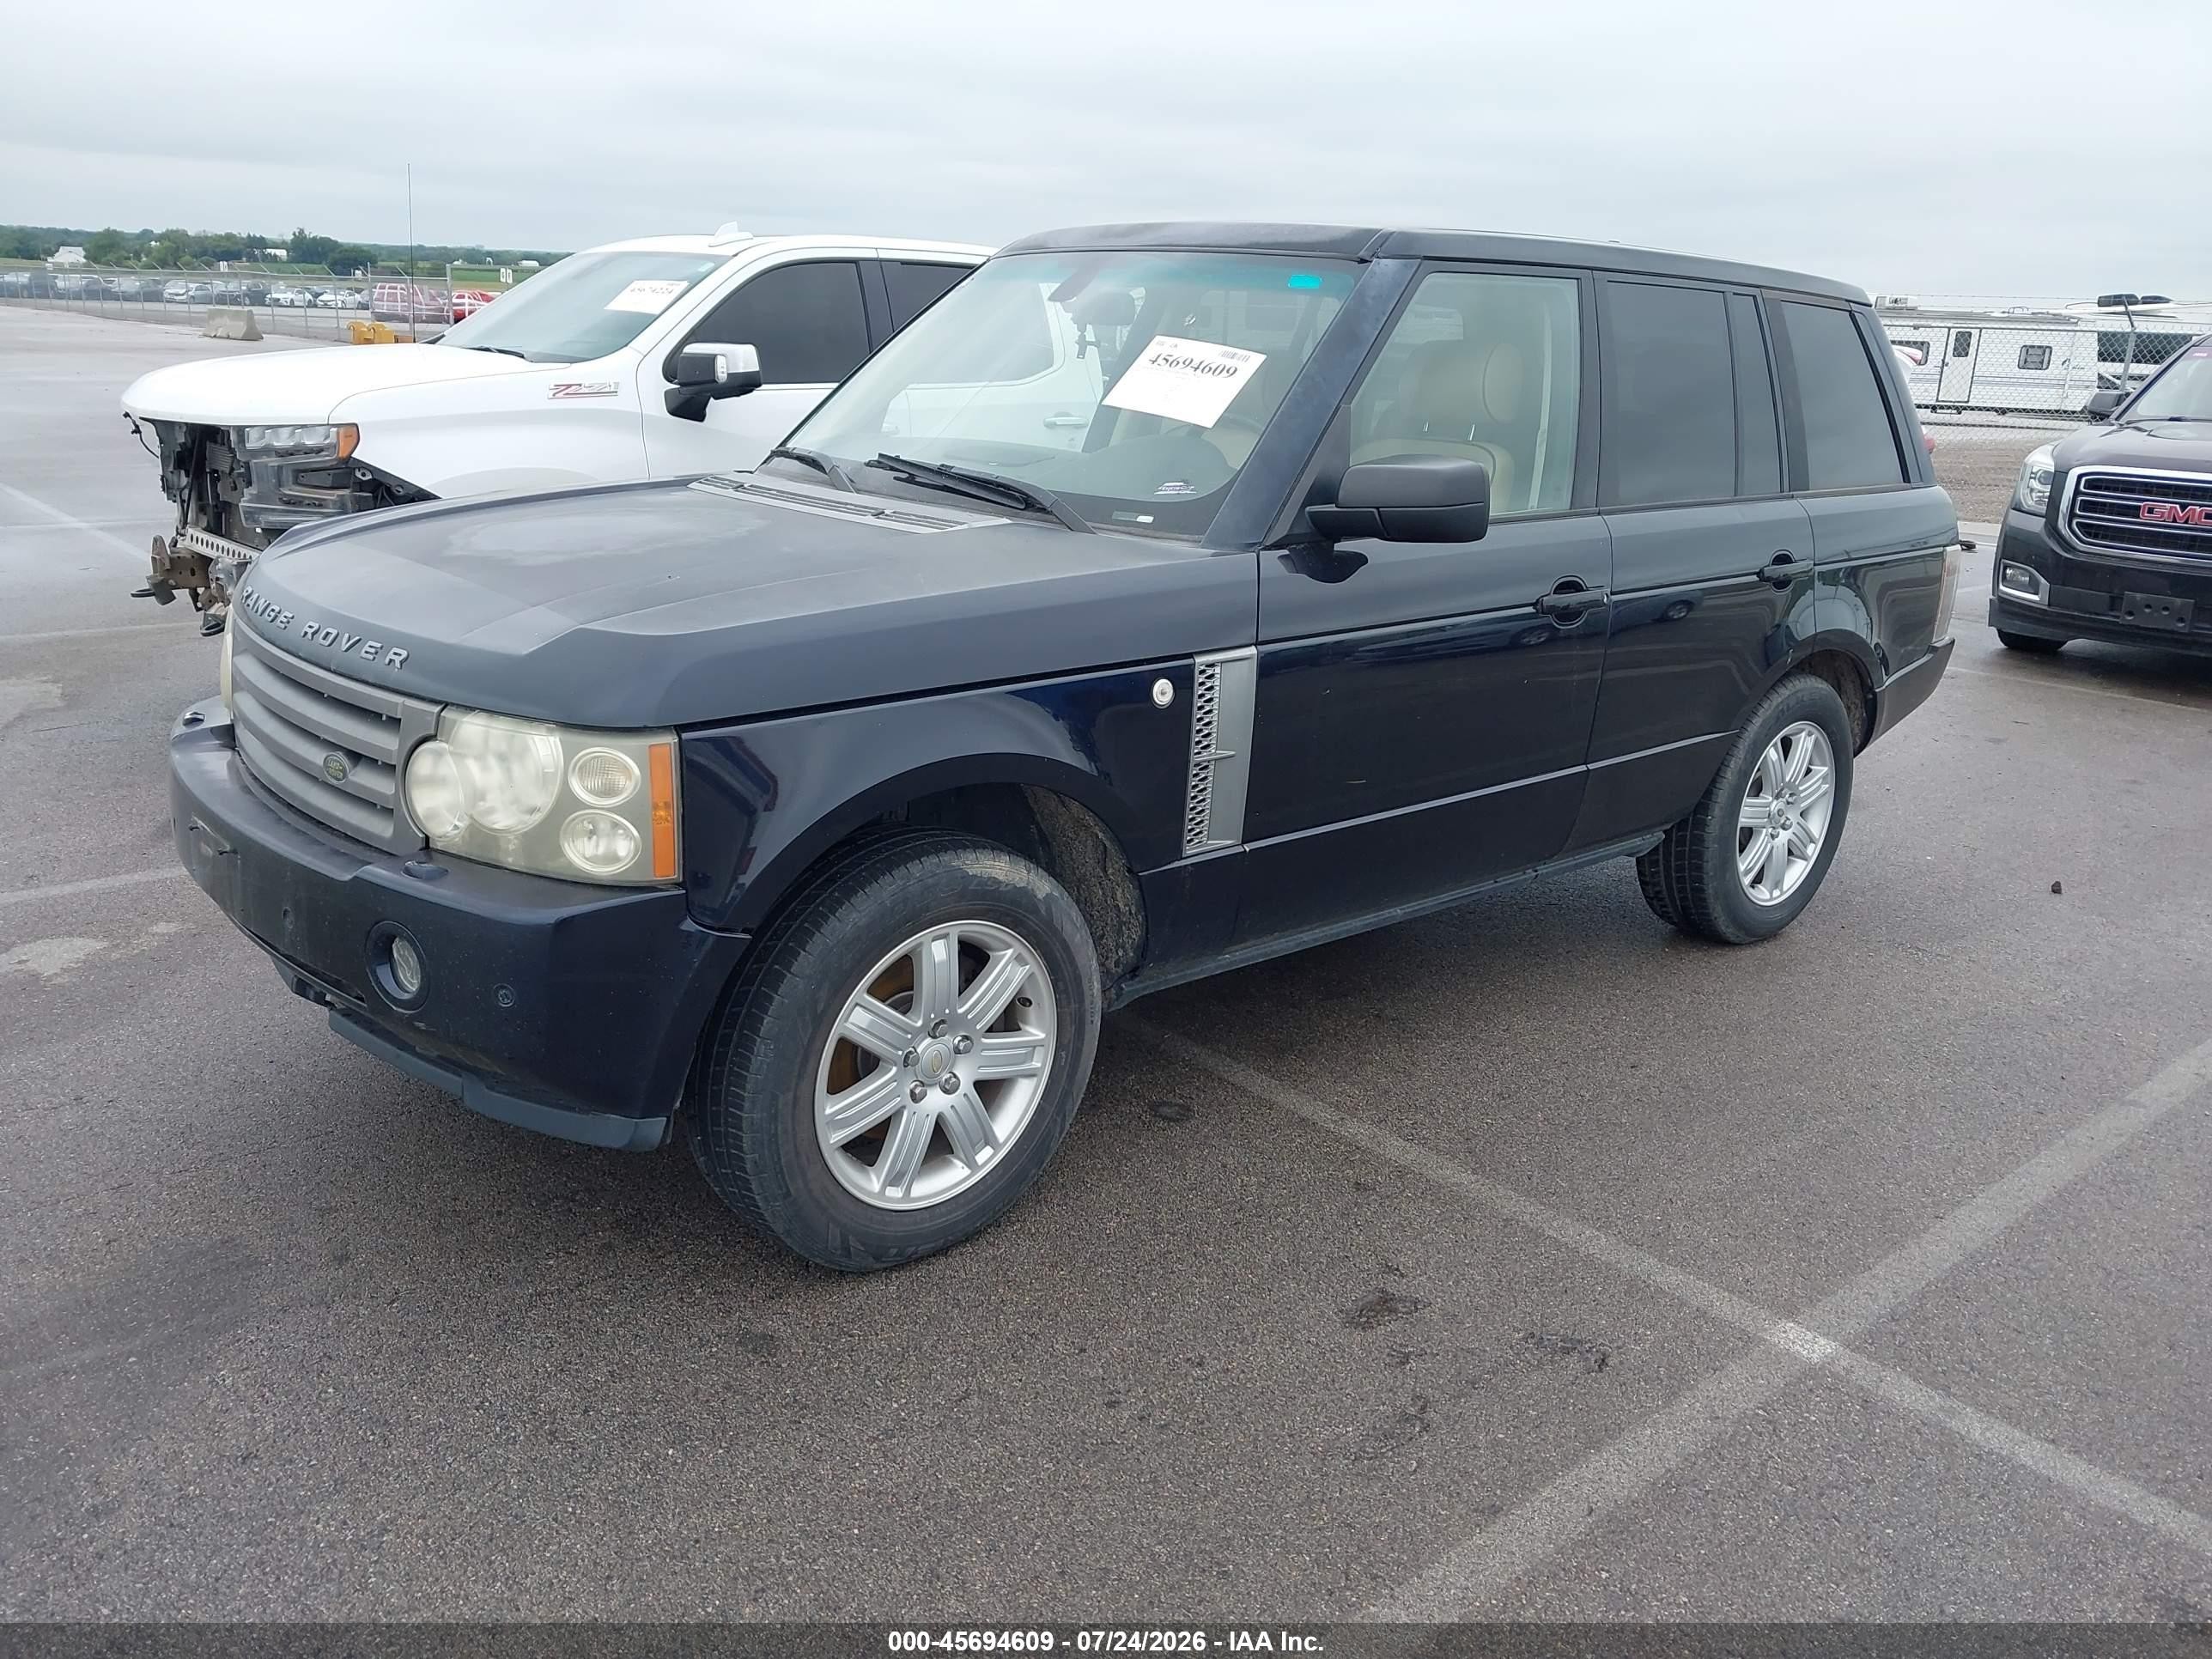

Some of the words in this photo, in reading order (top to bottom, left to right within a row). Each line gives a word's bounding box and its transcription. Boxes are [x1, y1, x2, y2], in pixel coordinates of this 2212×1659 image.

[1149, 352, 1238, 378] 45694609
[240, 586, 295, 630] RANGE
[301, 621, 409, 669] ROVER
